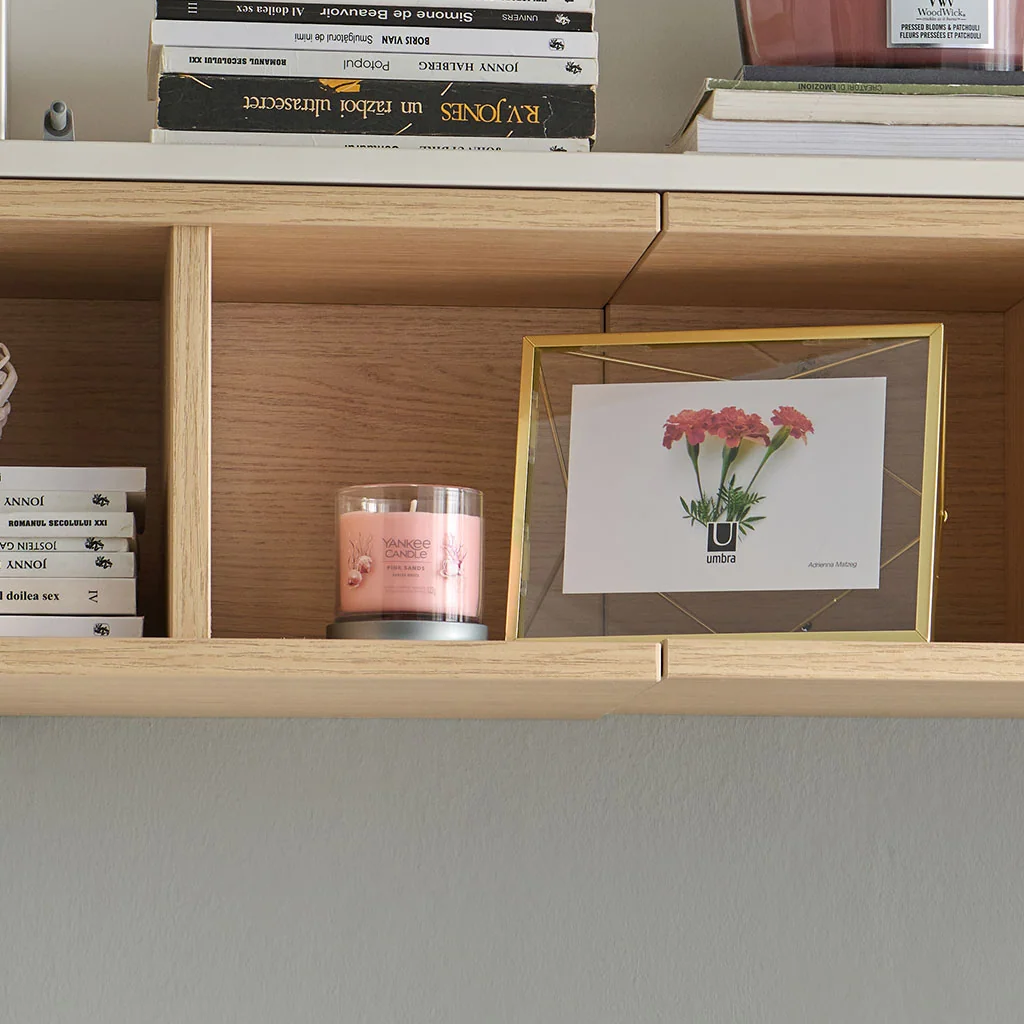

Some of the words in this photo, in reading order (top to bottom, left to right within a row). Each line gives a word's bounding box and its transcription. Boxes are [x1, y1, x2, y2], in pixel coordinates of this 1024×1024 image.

[235, 4, 254, 13] sex
[256, 5, 290, 16] doilea
[292, 6, 305, 16] Al
[319, 6, 388, 20] Beauvoir
[393, 9, 411, 20] de
[416, 10, 474, 23] Simone
[501, 14, 539, 22] UNIVERS
[901, 23, 925, 31] PRESSED
[925, 23, 947, 31] BLOOMS
[952, 24, 980, 32] PATCHOULI
[294, 33, 313, 42] inimi
[314, 33, 325, 43] de
[326, 31, 374, 45] Smulgătorul
[381, 35, 403, 45] VIAN
[899, 31, 919, 39] FLEURS
[920, 30, 947, 39] PRESSÉES
[954, 32, 982, 40] PATCHOULI
[405, 36, 431, 46] BORIS
[188, 56, 203, 64] XXI
[204, 57, 247, 65] SECOLULUI
[249, 57, 287, 66] ROMANUL
[343, 59, 390, 72] Potopul
[418, 60, 474, 72] HALBERG
[478, 61, 519, 73] JONNY
[798, 82, 837, 91] EMOZIONI
[243, 95, 332, 118] ultrasecret
[400, 101, 424, 115] un
[440, 98, 507, 125] JONES
[4, 496, 45, 506] JONNY
[8, 519, 47, 527] ROMANUL
[48, 519, 92, 527] SECOLULUI
[94, 519, 108, 527] XXI
[17, 541, 57, 551] JOSTEIN
[706, 553, 736, 564] umbra
[6, 559, 47, 570] JONNY
[6, 591, 39, 601] doilea
[42, 593, 60, 601] sex
